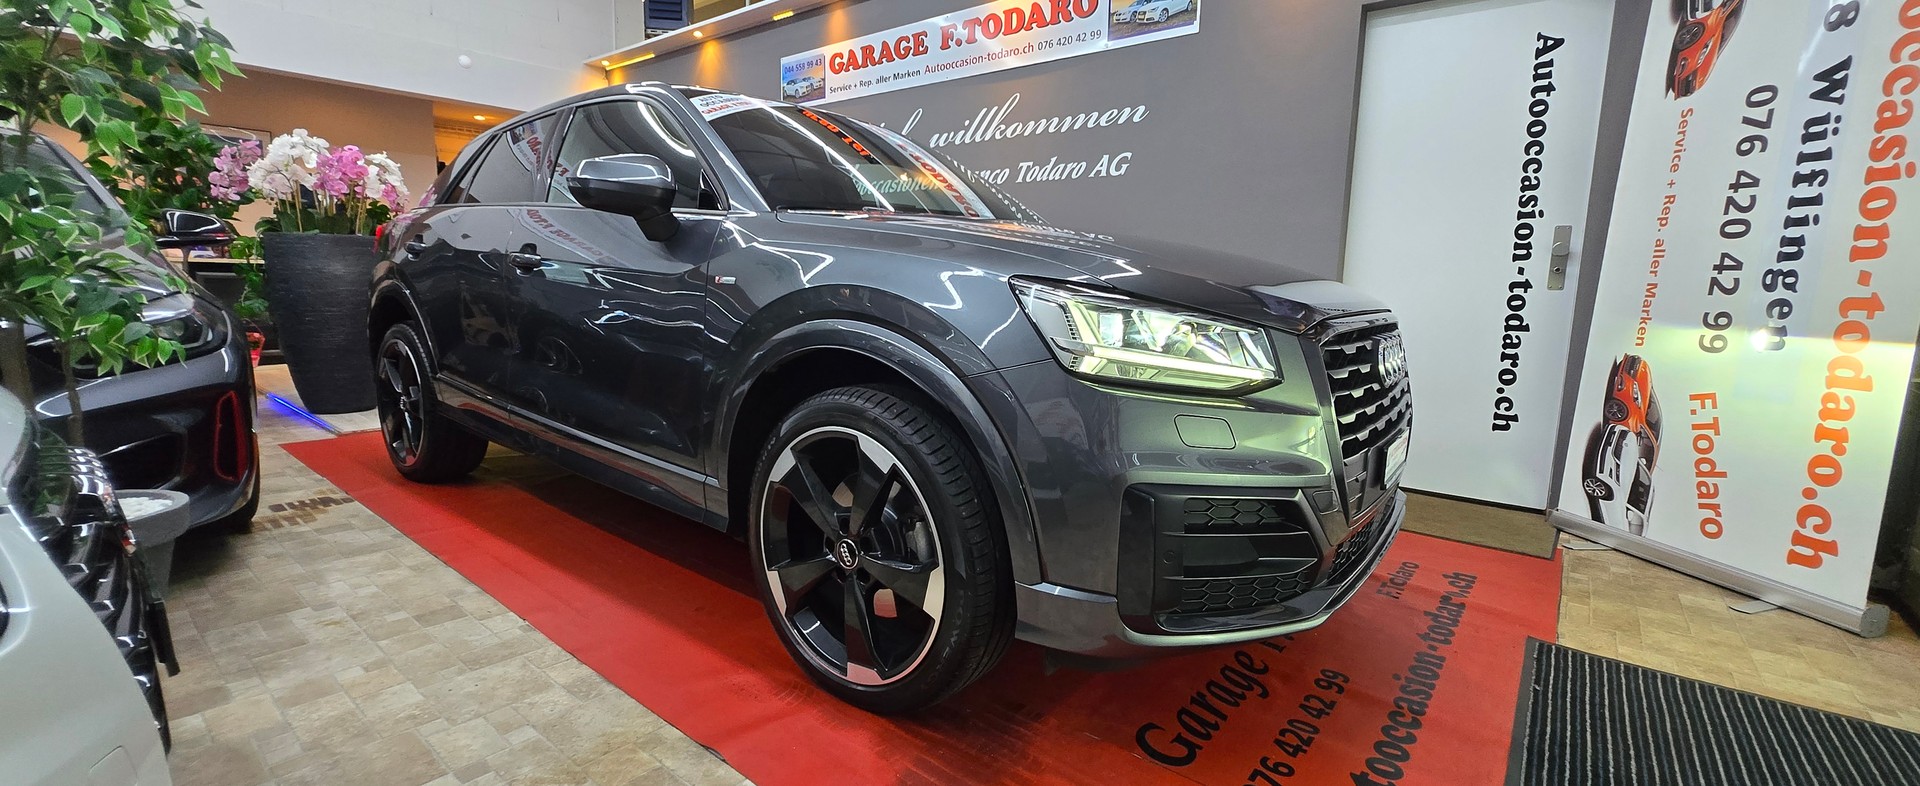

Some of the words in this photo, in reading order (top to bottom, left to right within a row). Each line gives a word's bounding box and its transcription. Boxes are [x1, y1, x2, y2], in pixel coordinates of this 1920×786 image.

[828, 30, 929, 75] GARAGE
[940, 0, 1099, 51] F.TODARO
[829, 82, 852, 94] Service
[859, 78, 874, 89] Rep.
[875, 74, 891, 85] aller
[893, 68, 921, 82] Marken
[924, 41, 1034, 76] Autooccasion-todaro.ch
[1037, 39, 1054, 52] 076
[1056, 35, 1073, 47] 420
[1075, 32, 1087, 44] 42
[1090, 29, 1102, 40] 99
[929, 92, 1150, 149] willkommen
[1669, 107, 1694, 173] Service
[1736, 84, 1779, 158] 076
[1015, 155, 1088, 184] Todaro
[1088, 151, 1133, 178] AG
[1491, 31, 1566, 433] Autooccasion-todaro.ch
[1656, 194, 1676, 232] Rep.
[1719, 170, 1761, 240] 420
[1760, 54, 1853, 351] Wülflingen
[1649, 238, 1666, 277] aller
[1707, 252, 1744, 296] 42
[1635, 282, 1658, 347] Marken
[1698, 311, 1733, 354] 99
[1689, 392, 1728, 540] F.Todaro
[1135, 650, 1270, 767] Garage
[1298, 694, 1337, 720] 42
[1313, 668, 1350, 695] 99
[1273, 718, 1321, 758] 420
[1243, 756, 1296, 786] 76
